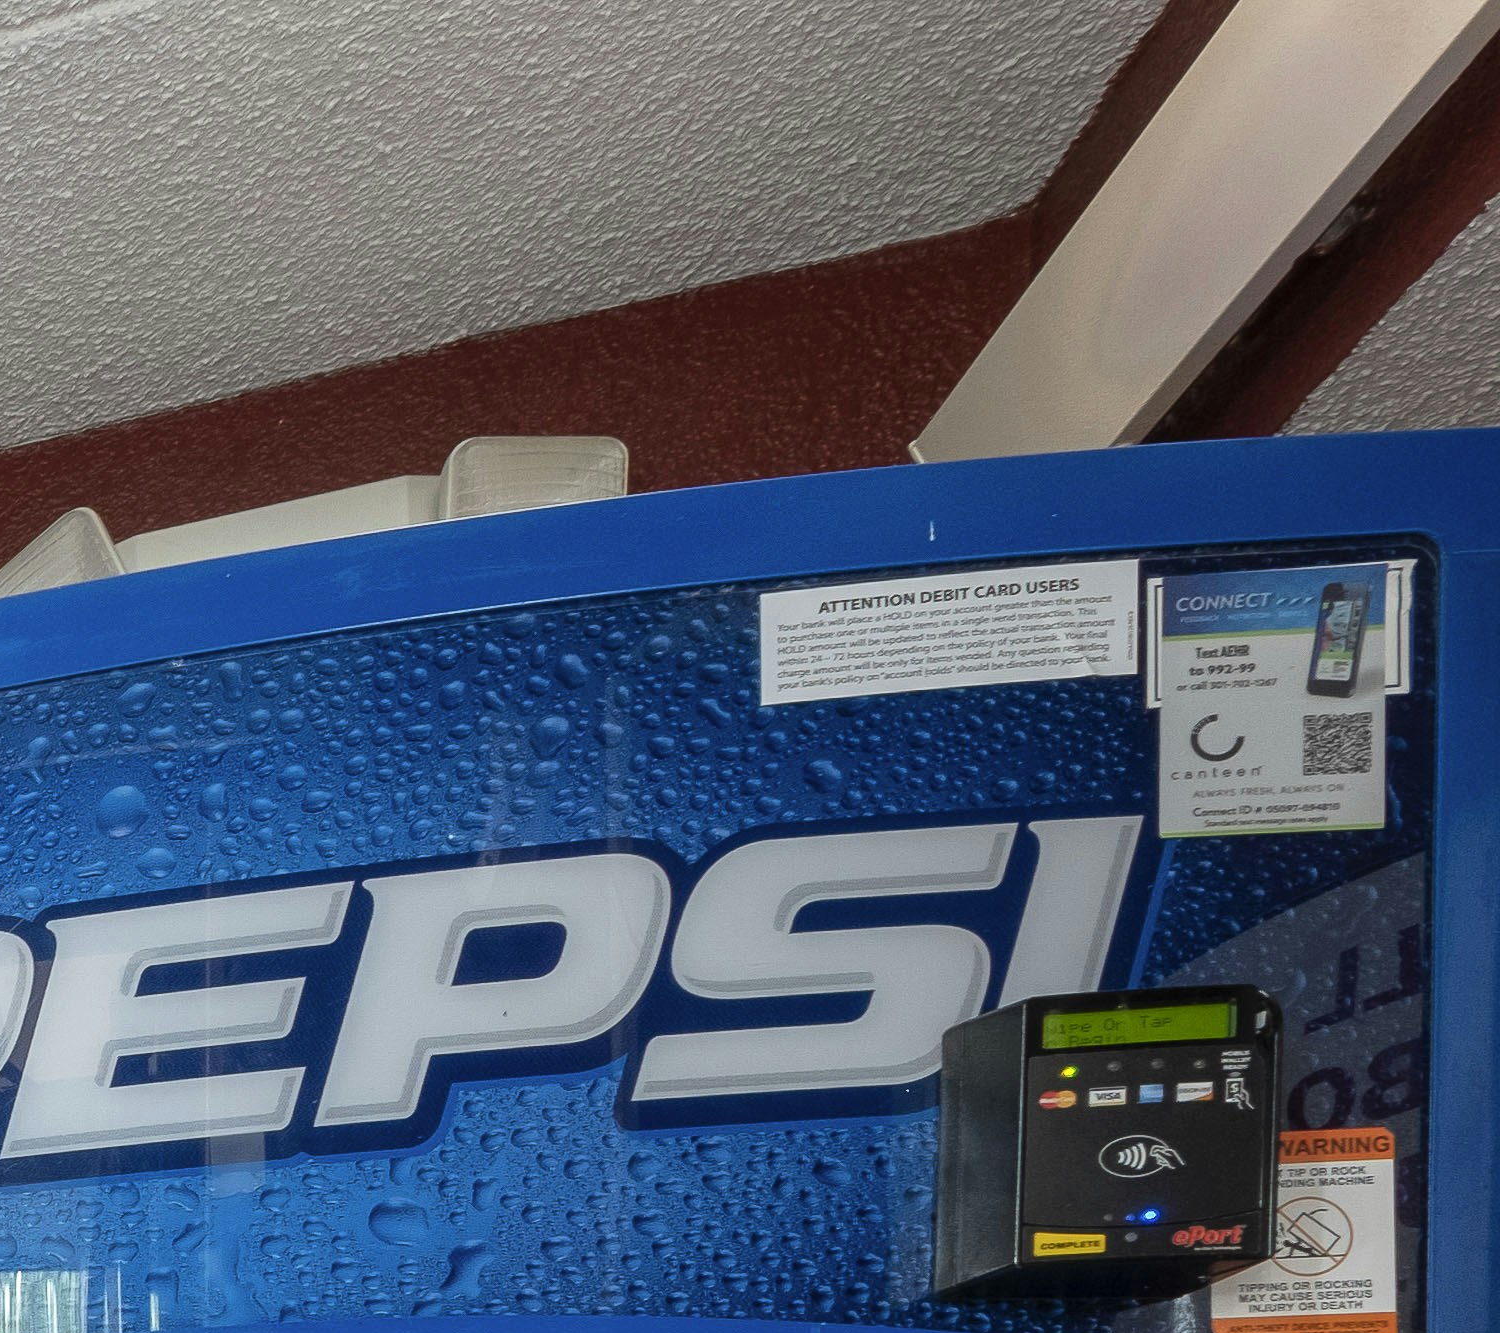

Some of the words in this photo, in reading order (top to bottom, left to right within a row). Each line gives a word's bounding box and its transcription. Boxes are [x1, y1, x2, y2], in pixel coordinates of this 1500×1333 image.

[818, 591, 916, 614] ATTENTION
[920, 587, 969, 604] DEBIT
[973, 582, 1022, 599] CARD
[1027, 578, 1079, 595] USERS
[1176, 592, 1273, 612] CONNECT
[1171, 765, 1262, 781] canteen
[1288, 1166, 1306, 1177] TIP
[1310, 1166, 1327, 1177] OR
[1331, 1165, 1367, 1176] ROCK
[1319, 1176, 1375, 1187] MACHINE
[1172, 1224, 1244, 1248] ePort
[1040, 1240, 1101, 1251] COMPLETE
[1238, 1282, 1288, 1293] TIPPING
[1315, 1279, 1373, 1291] ROCKING
[1238, 1293, 1265, 1303] MAY
[1269, 1292, 1310, 1303] CAUSE
[1314, 1289, 1373, 1300] SERIOUS
[1248, 1303, 1295, 1313] INJURY
[1321, 1301, 1364, 1311] DEATH
